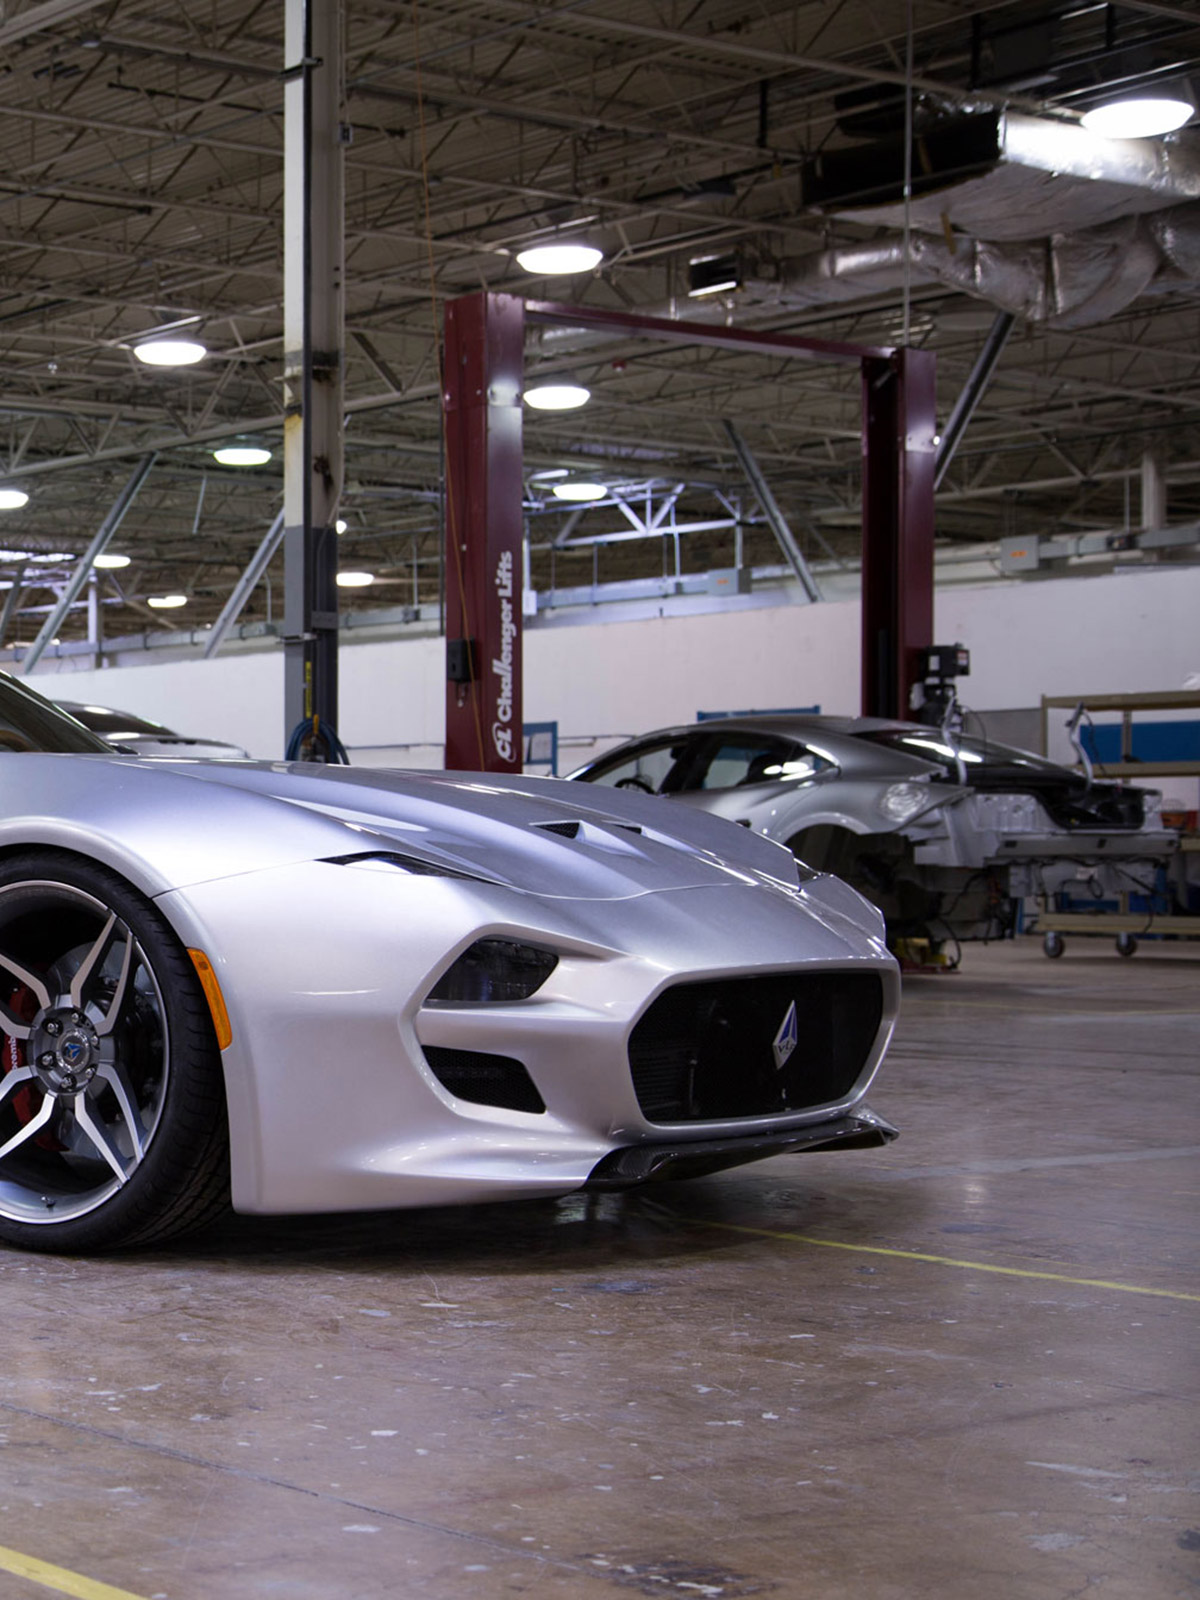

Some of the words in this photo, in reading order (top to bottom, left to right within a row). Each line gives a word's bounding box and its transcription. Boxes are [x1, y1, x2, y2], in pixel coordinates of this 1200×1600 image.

[495, 550, 513, 598] Lifts
[492, 599, 516, 723] Challenger
[7, 1036, 18, 1070] bremb
